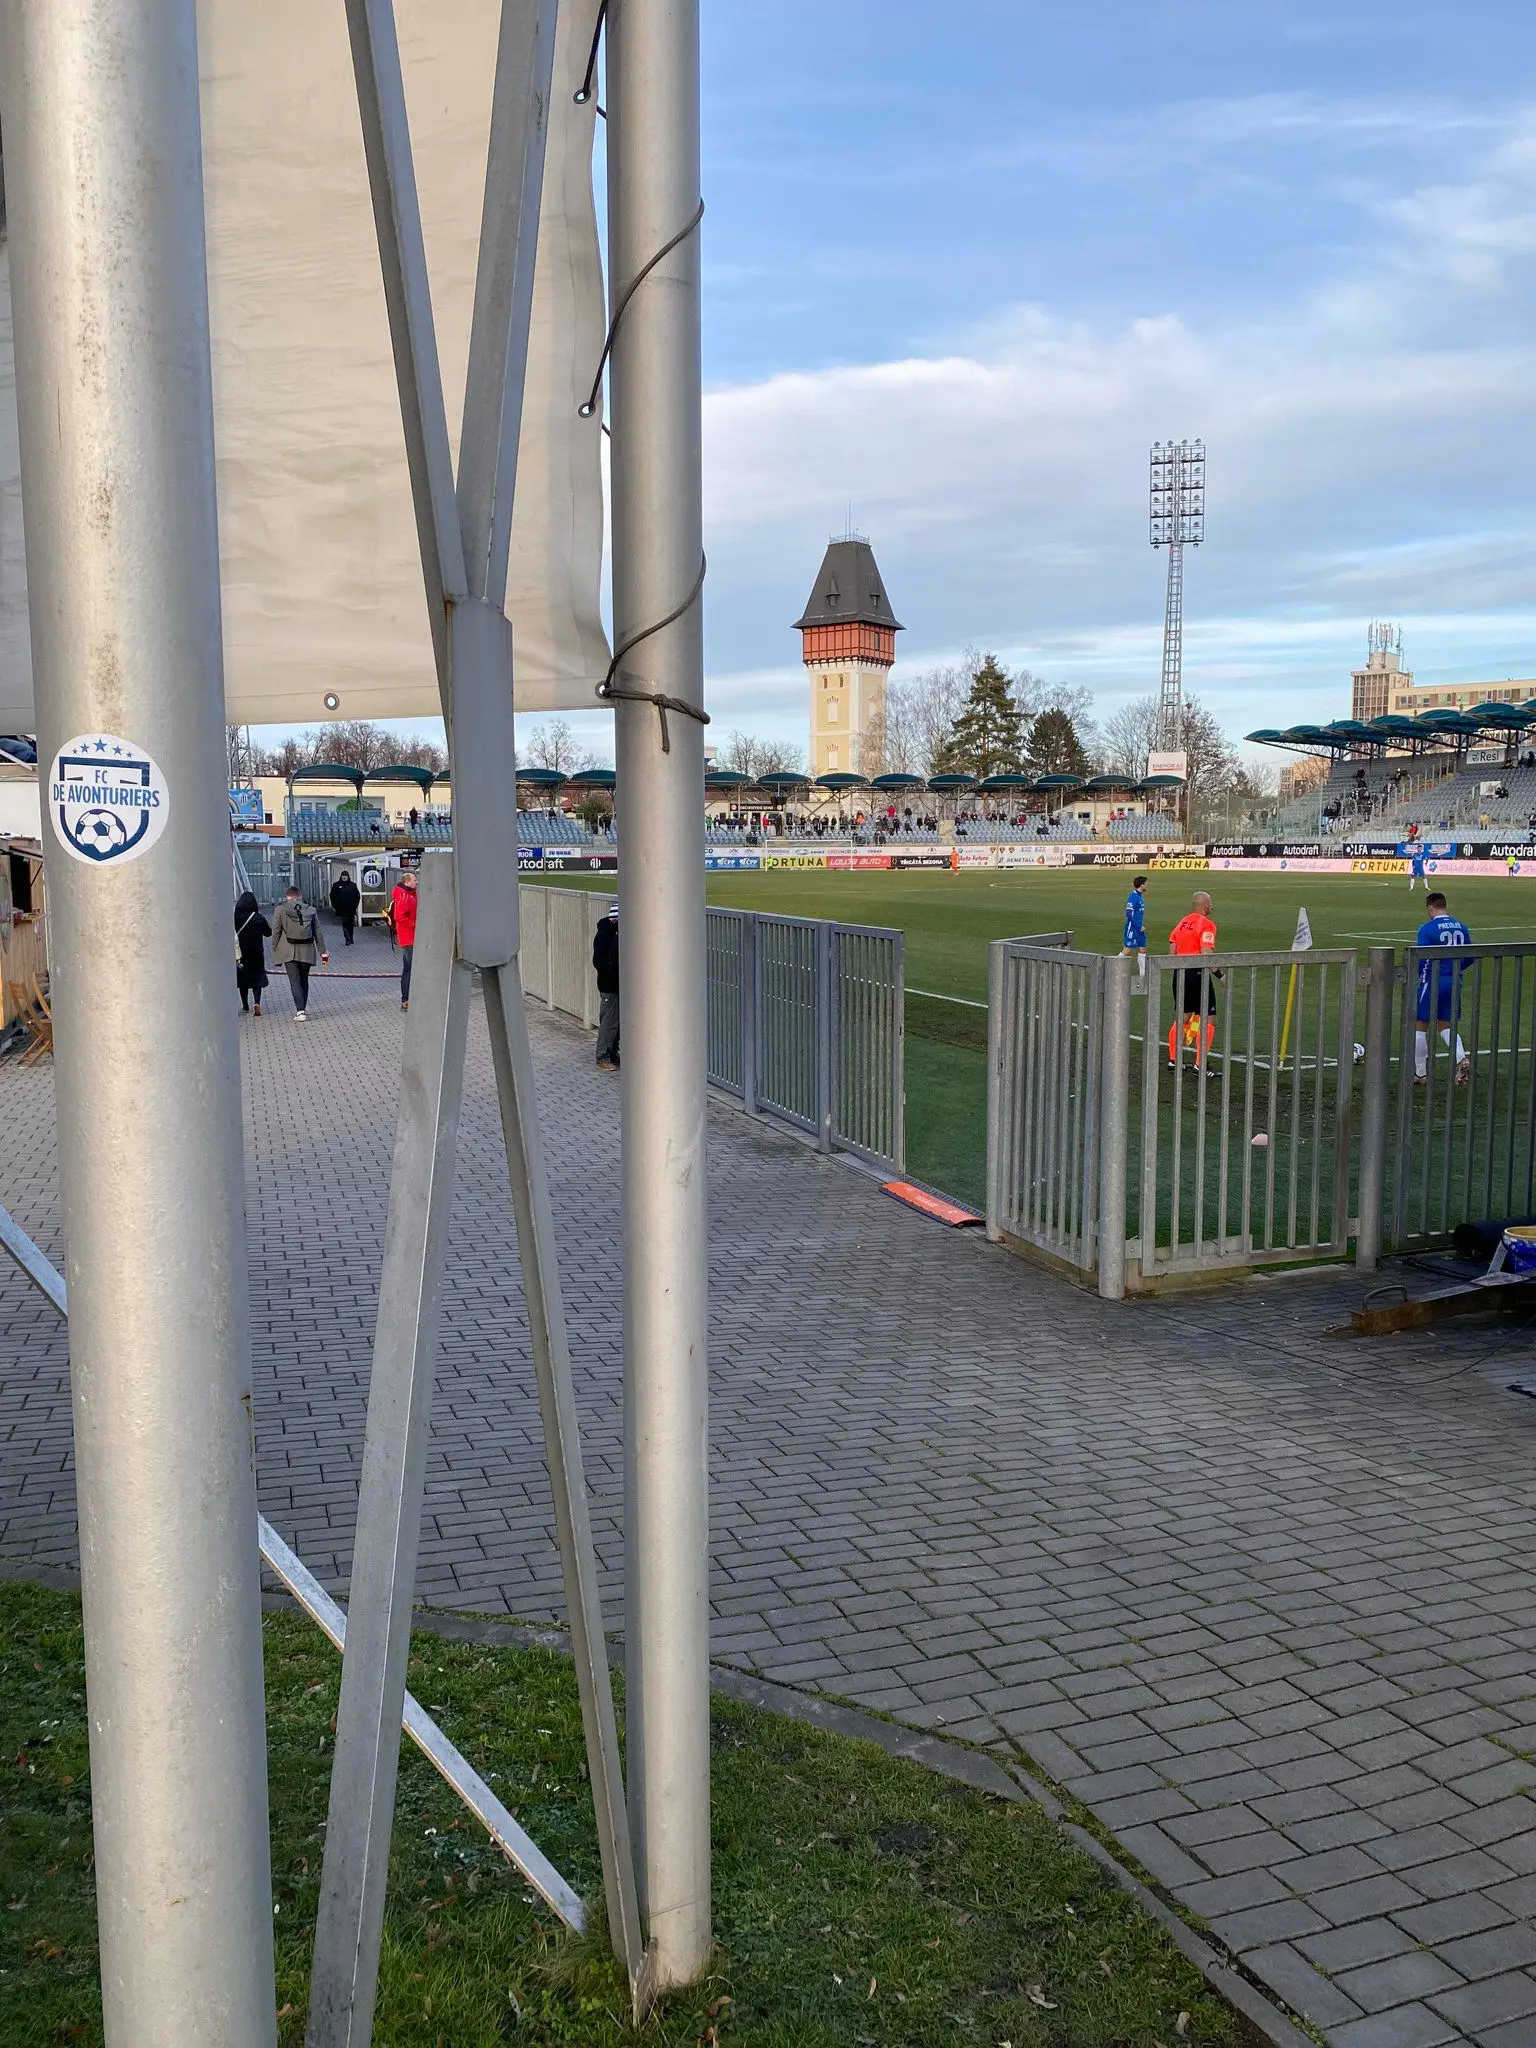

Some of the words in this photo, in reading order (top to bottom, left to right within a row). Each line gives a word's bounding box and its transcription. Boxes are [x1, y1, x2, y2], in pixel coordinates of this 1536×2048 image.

[95, 770, 108, 784] FC
[53, 784, 65, 801] DE
[68, 785, 160, 808] AVONTURIERS
[1212, 845, 1245, 856] Autodraft
[1283, 844, 1320, 856] Autodraft
[1151, 860, 1210, 869] FORTUNA
[1352, 860, 1406, 872] FORTUNA
